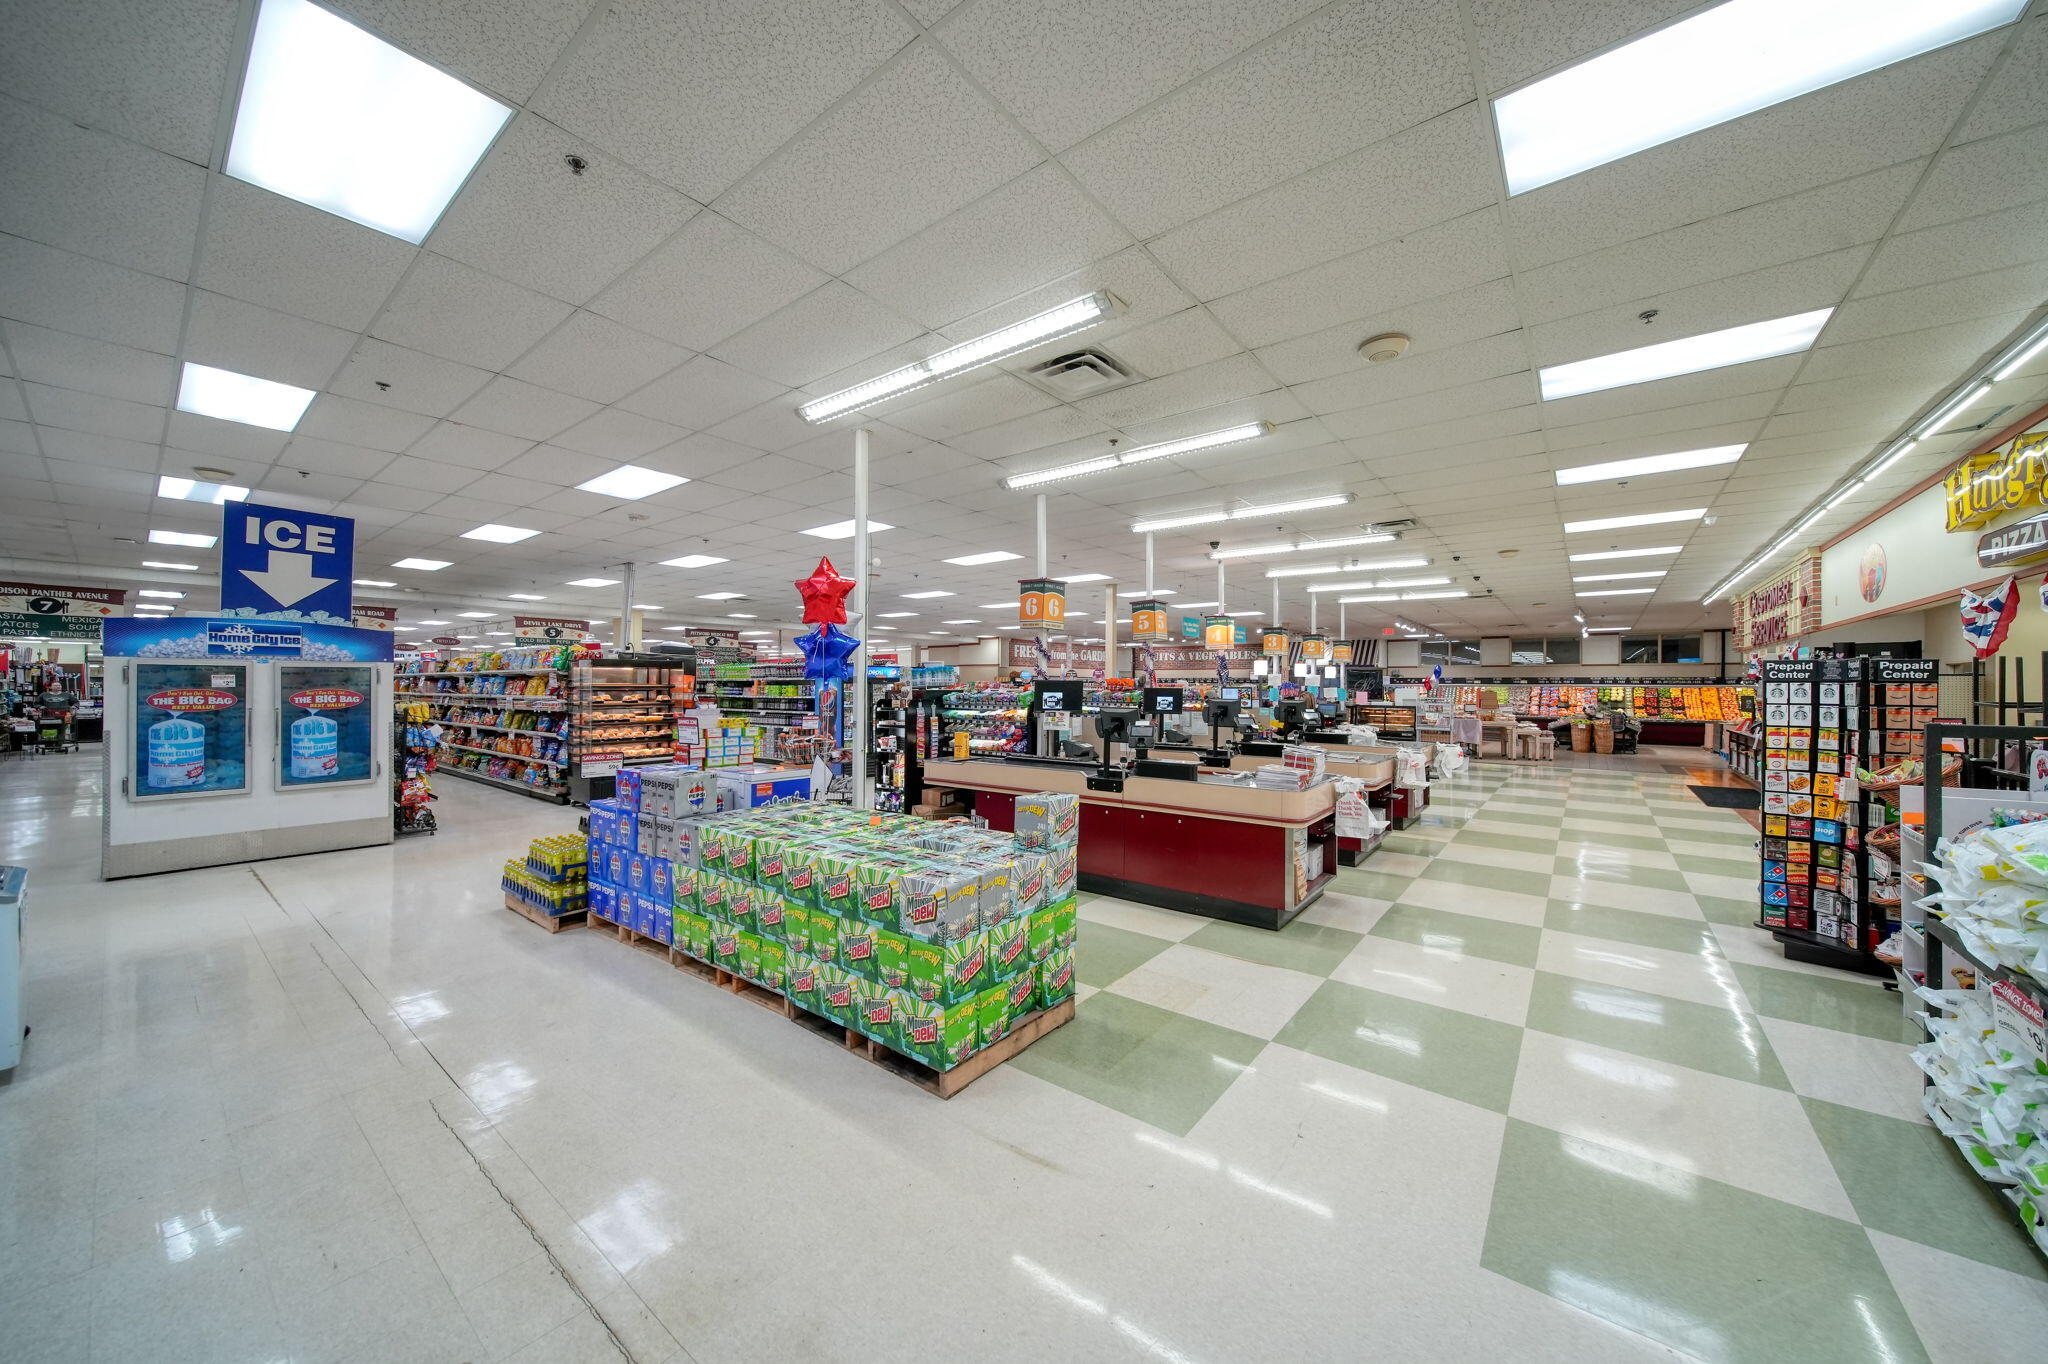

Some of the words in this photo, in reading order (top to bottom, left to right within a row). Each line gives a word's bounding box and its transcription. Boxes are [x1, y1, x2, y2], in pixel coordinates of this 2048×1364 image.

[245, 516, 336, 554] ICE
[1992, 521, 2047, 560] PIZZA
[31, 589, 73, 598] PANTHER
[75, 592, 109, 600] AVENUE
[1749, 580, 1790, 617] CUSTOMER
[40, 601, 53, 611] 7
[1026, 598, 1038, 616] 6
[1048, 598, 1060, 617] 6
[1138, 615, 1150, 630] 5
[3, 628, 39, 636] PASTA
[1751, 614, 1787, 646] SERVICE
[208, 632, 250, 644] Home
[252, 633, 279, 646] City
[280, 635, 301, 645] Ice
[709, 637, 715, 645] 4
[1211, 631, 1221, 642] 4
[1268, 637, 1277, 647] 3
[1307, 642, 1316, 651] 2
[1014, 645, 1037, 658] FRES
[1051, 650, 1067, 660] from
[1071, 650, 1079, 660] he
[1188, 650, 1258, 661] VEGEABLES
[1766, 662, 1813, 673] Prepaid
[1880, 661, 1933, 671] Prepaid
[1769, 671, 1810, 679] Center
[1882, 670, 1930, 679] Center
[178, 696, 205, 705] BIG
[208, 696, 233, 705] BAG
[315, 695, 337, 703] BIG
[640, 778, 657, 789] PEPSI
[657, 781, 674, 792] PEPSI
[688, 792, 706, 800] PEPSI
[601, 810, 616, 820] PEPSI
[656, 821, 674, 832] PEPSI
[601, 885, 616, 897] PEPSI
[638, 898, 654, 910] PEPSI
[655, 904, 672, 917] PEPSI
[1995, 982, 2022, 1008] SAVINGS
[2022, 1001, 2044, 1023] ZONE!
